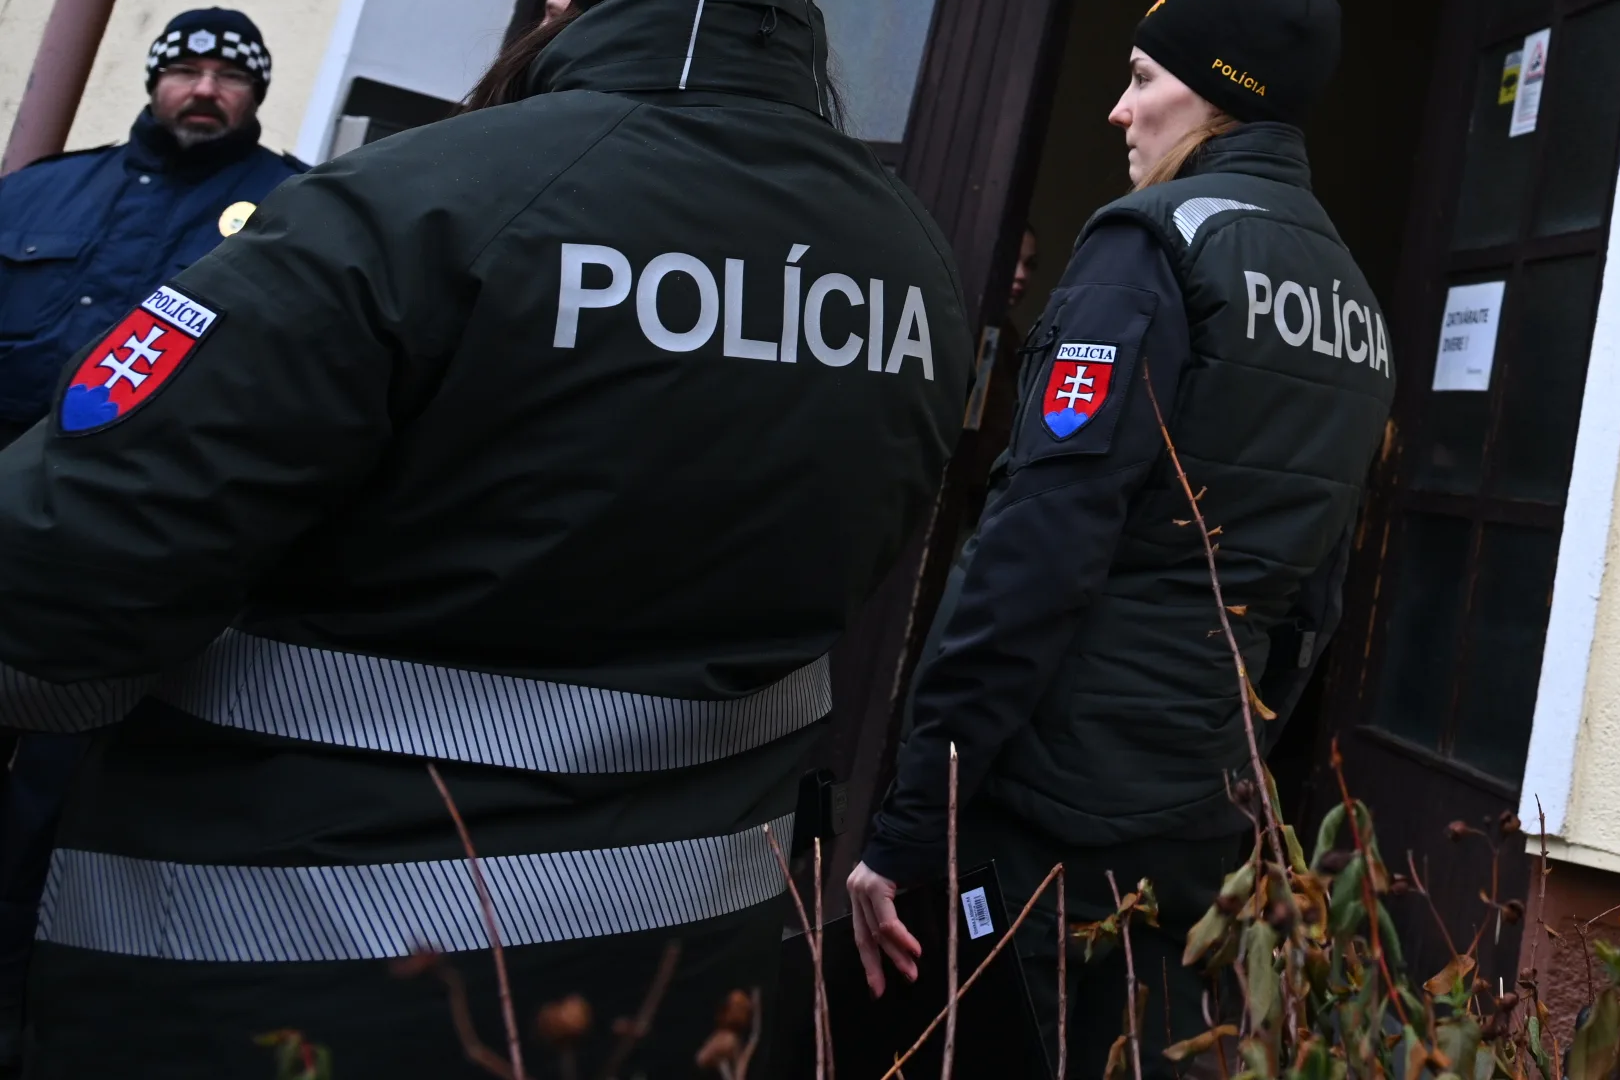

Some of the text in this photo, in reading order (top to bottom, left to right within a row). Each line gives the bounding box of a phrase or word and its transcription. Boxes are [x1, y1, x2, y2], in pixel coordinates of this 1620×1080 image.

[1211, 58, 1266, 97] POLÍCIA
[147, 290, 208, 333] POLÍCIA
[553, 242, 935, 381] POLÍCIA
[1243, 270, 1390, 379] POLÍCIA
[1060, 345, 1114, 360] POLÍCIA
